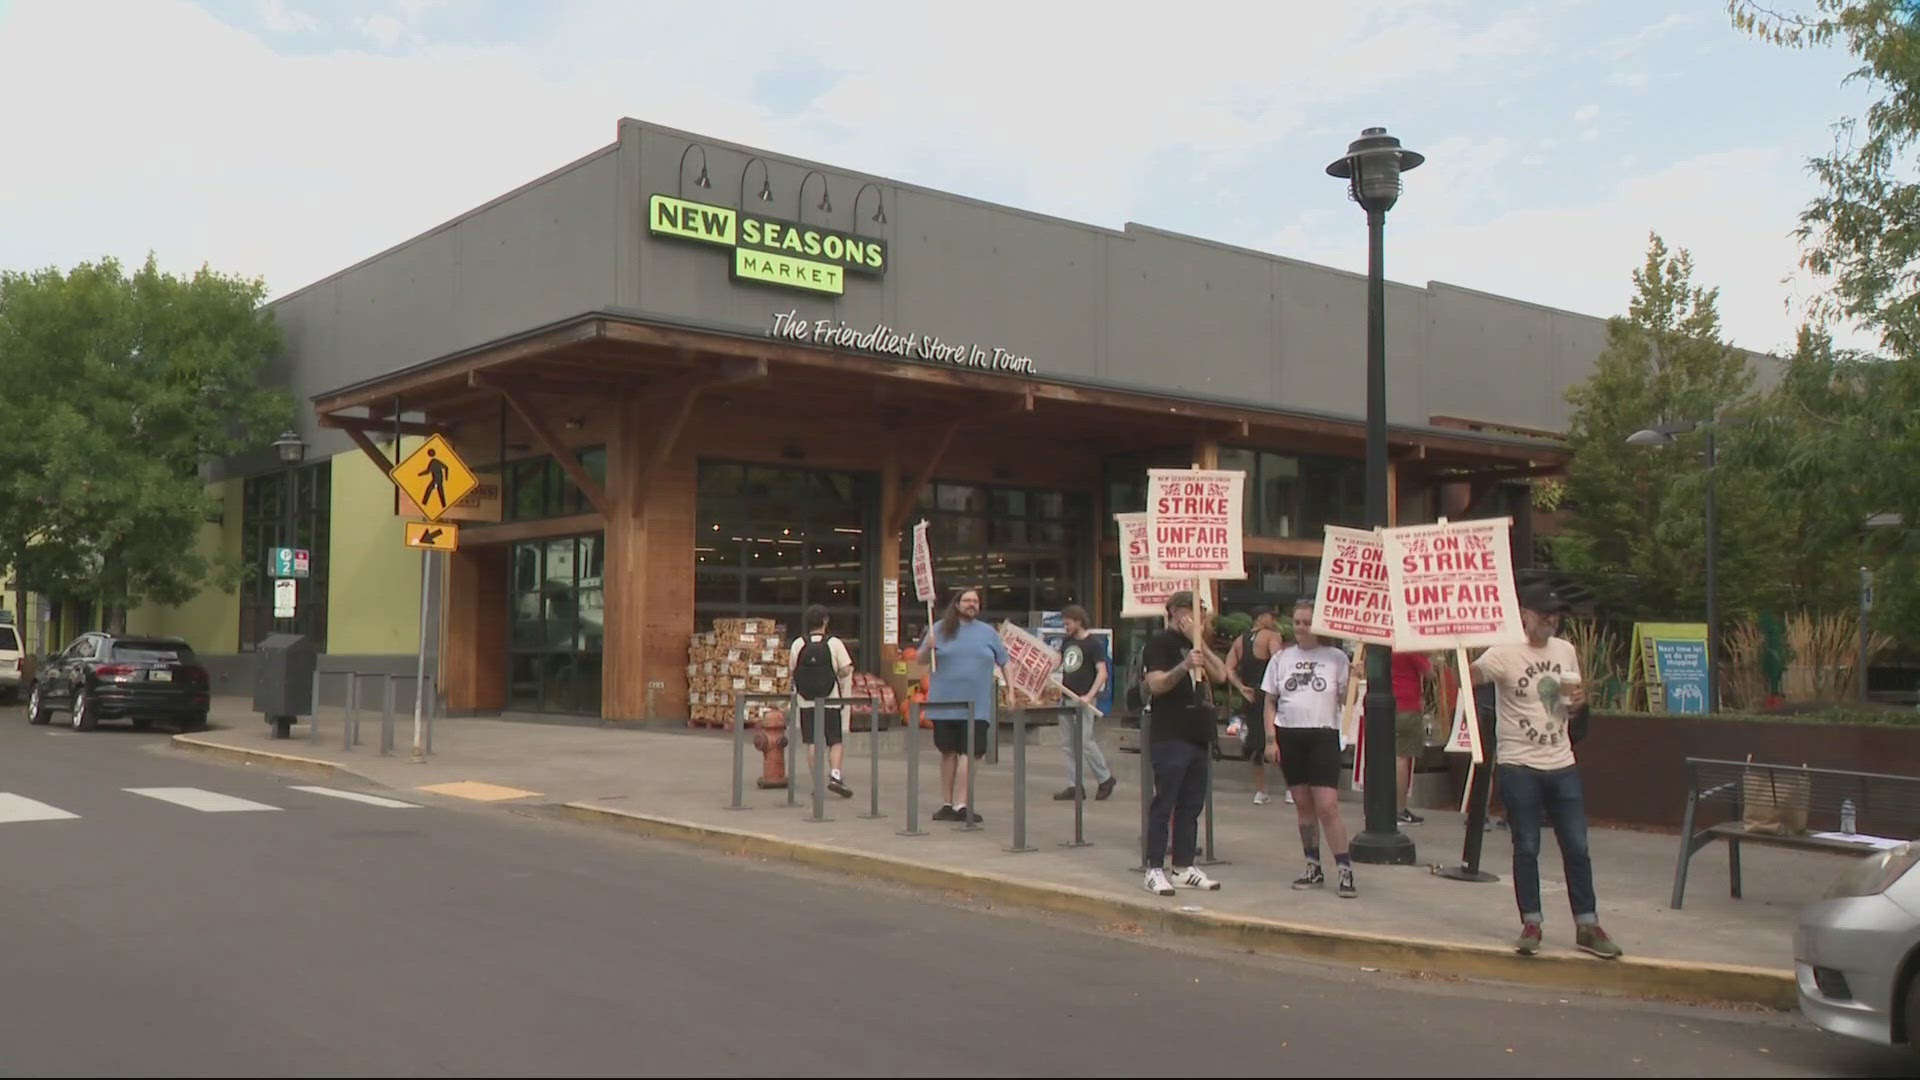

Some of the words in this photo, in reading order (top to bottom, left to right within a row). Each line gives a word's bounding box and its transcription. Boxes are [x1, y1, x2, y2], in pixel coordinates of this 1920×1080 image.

[657, 201, 729, 238] NEW
[742, 219, 884, 267] SEASONS
[743, 256, 836, 286] MARKET
[773, 309, 808, 339] The
[813, 319, 917, 356] Friendliest
[918, 335, 965, 364] Store
[968, 344, 987, 367] In
[991, 347, 1037, 374] Town.
[1184, 483, 1204, 496] ON
[1158, 498, 1229, 515] STRIKE
[1156, 527, 1227, 544] UNFAIR
[1433, 536, 1459, 552] ON
[1157, 547, 1229, 558] EMPLOYER
[1361, 548, 1383, 562] ON
[283, 561, 290, 572] 2
[1402, 550, 1496, 573] STRIKE
[1404, 584, 1500, 605] UNFAIR
[1407, 605, 1503, 623] EMPLOYER
[1515, 661, 1561, 697] FORWA
